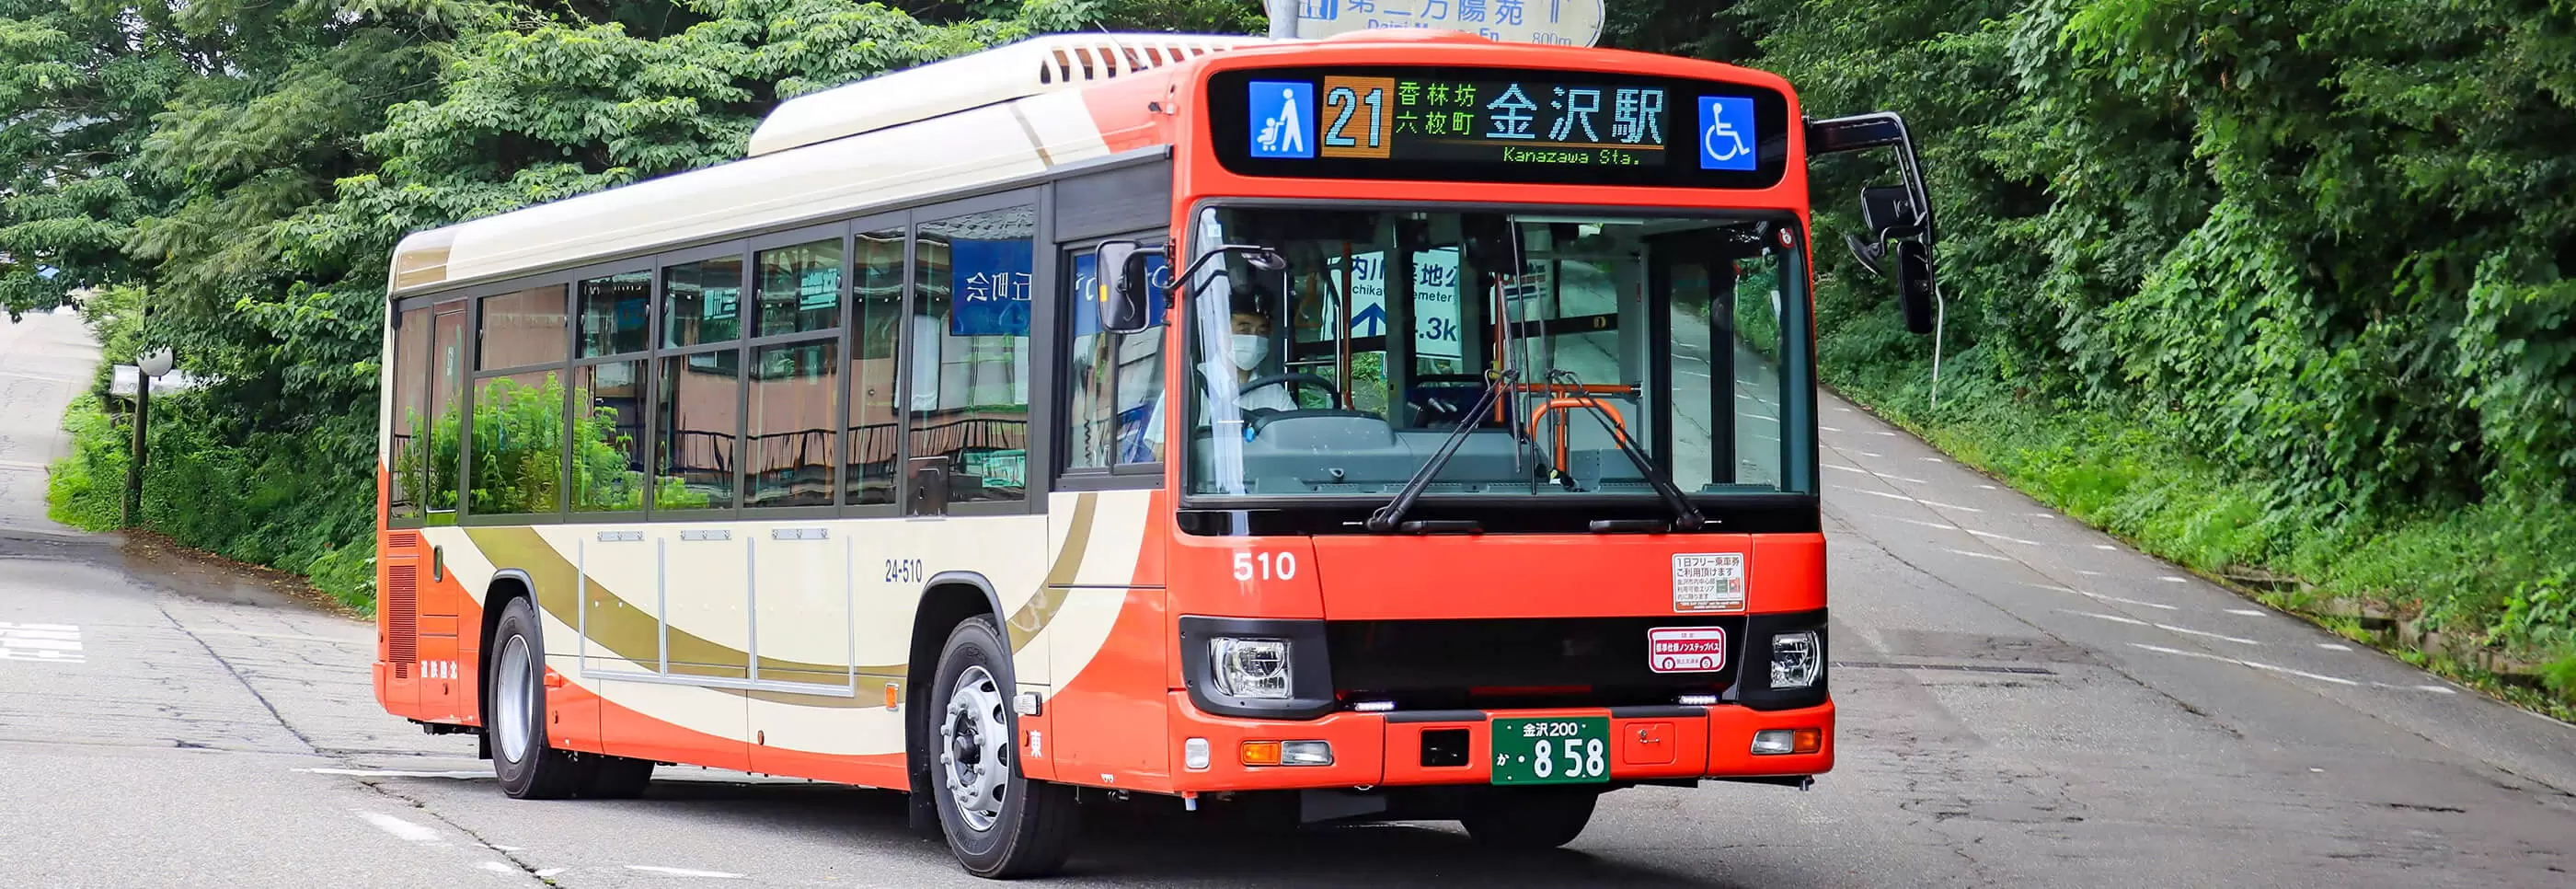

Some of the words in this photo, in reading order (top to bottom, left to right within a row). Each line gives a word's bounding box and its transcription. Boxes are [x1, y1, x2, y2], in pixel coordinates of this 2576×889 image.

[1397, 81, 1477, 108] 香林坊
[1325, 87, 1383, 147] 21
[1395, 110, 1475, 135] 六枚町
[1486, 83, 1664, 144] 金沢駅
[1503, 146, 1589, 165] Kanazawa
[1599, 149, 1640, 166] Sta.
[1414, 317, 1457, 342] .3k
[885, 558, 923, 583] 24-510
[1233, 551, 1296, 581] 510
[1496, 753, 1510, 767] か
